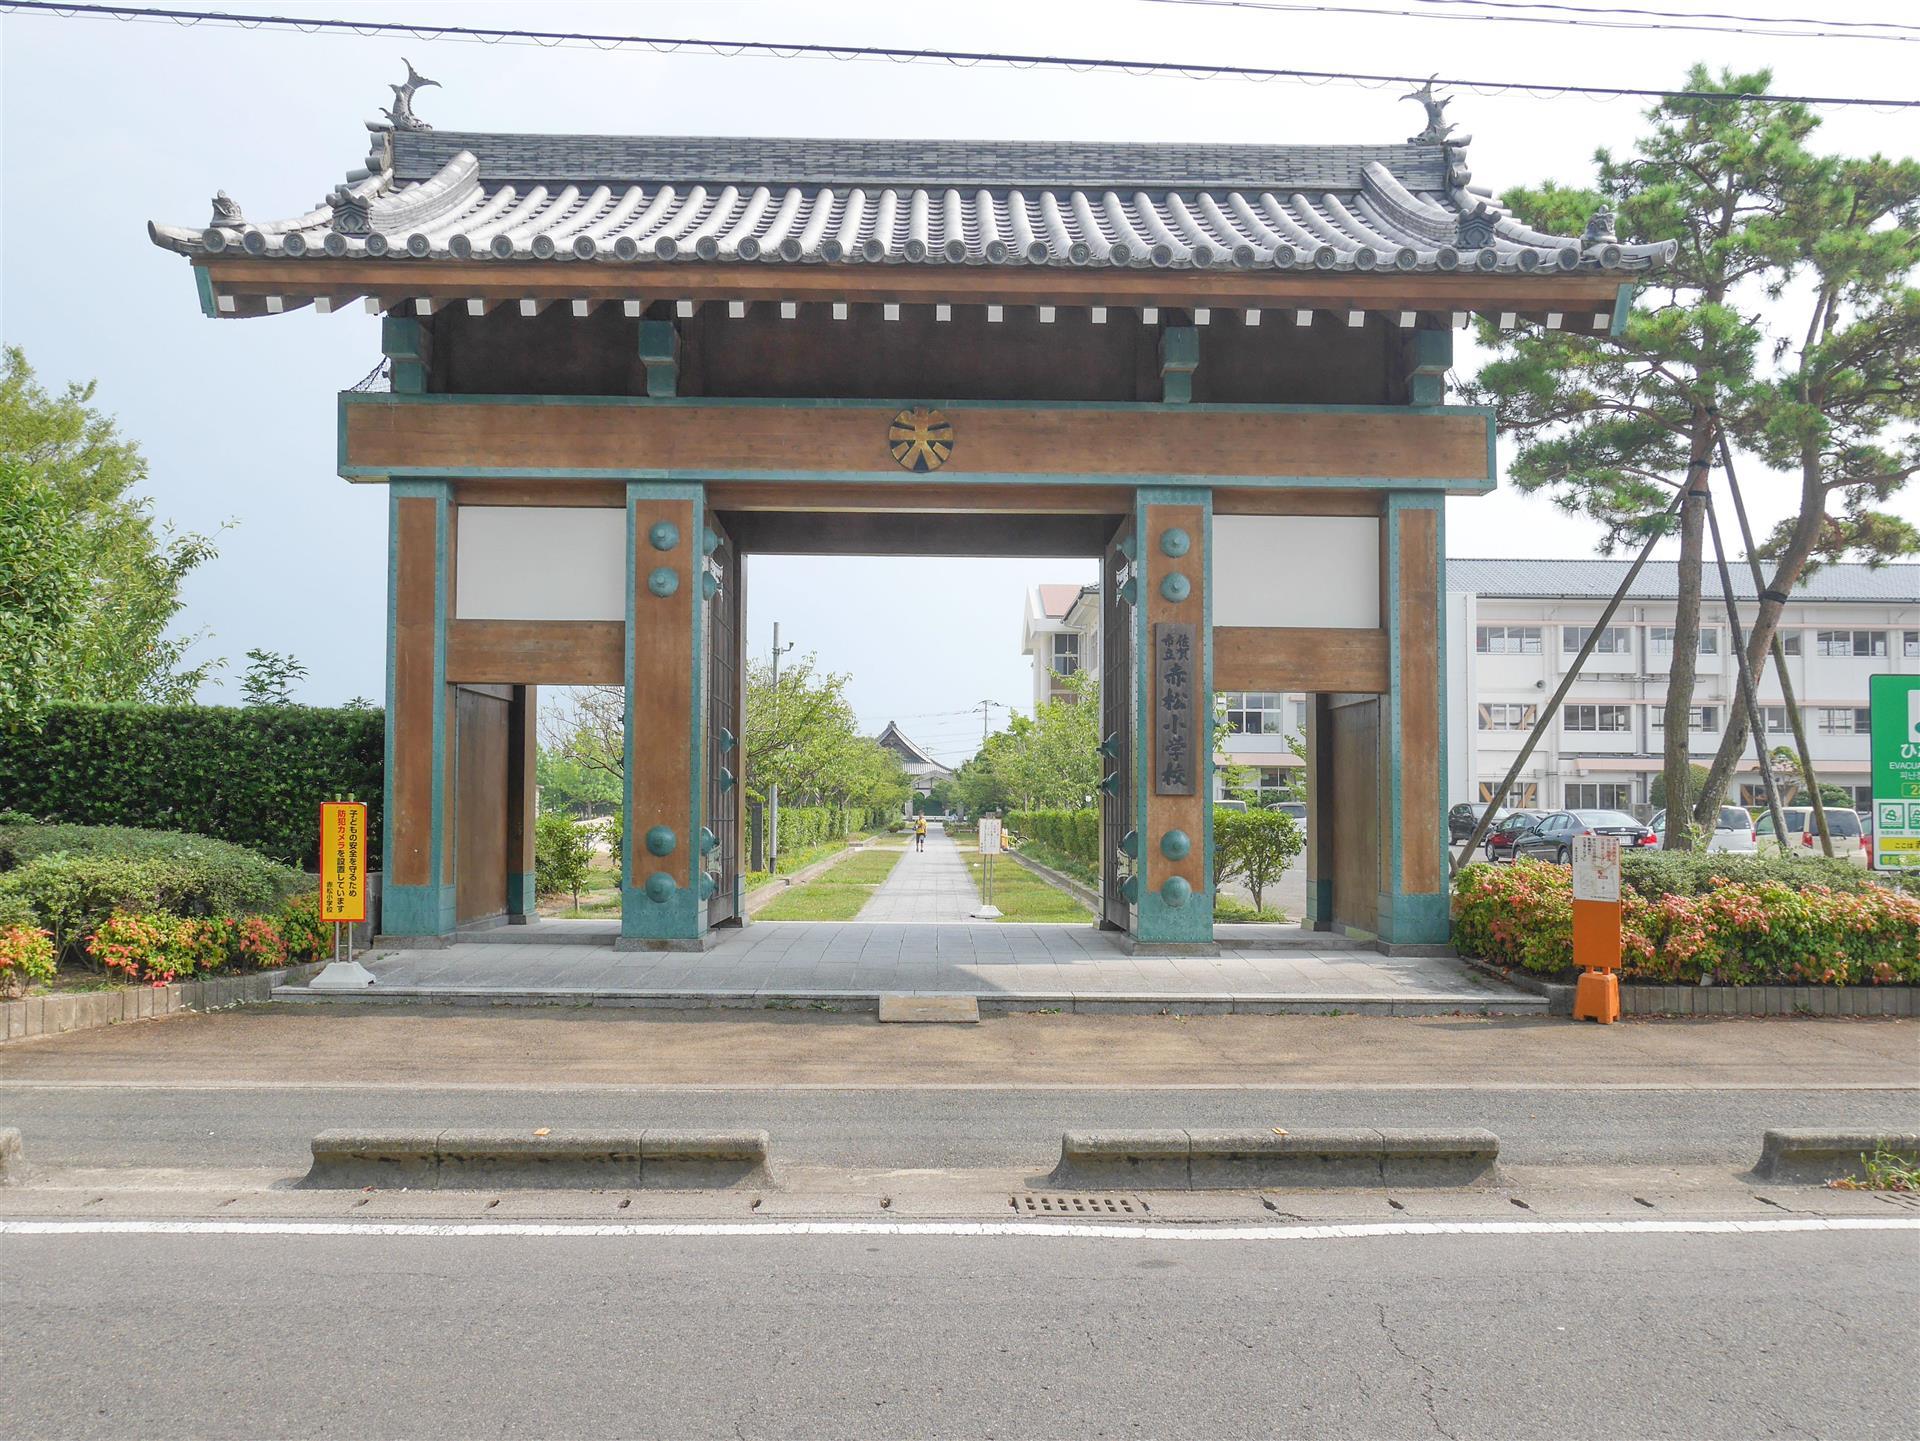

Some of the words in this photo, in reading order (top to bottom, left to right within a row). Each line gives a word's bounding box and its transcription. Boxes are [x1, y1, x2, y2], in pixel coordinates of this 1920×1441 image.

[1162, 662, 1188, 786] 赤松小学校
[1900, 743, 1920, 759] ひ
[337, 809, 346, 912] 防犯カメラを設置しています
[349, 809, 358, 897] 子どもの安全を守るため
